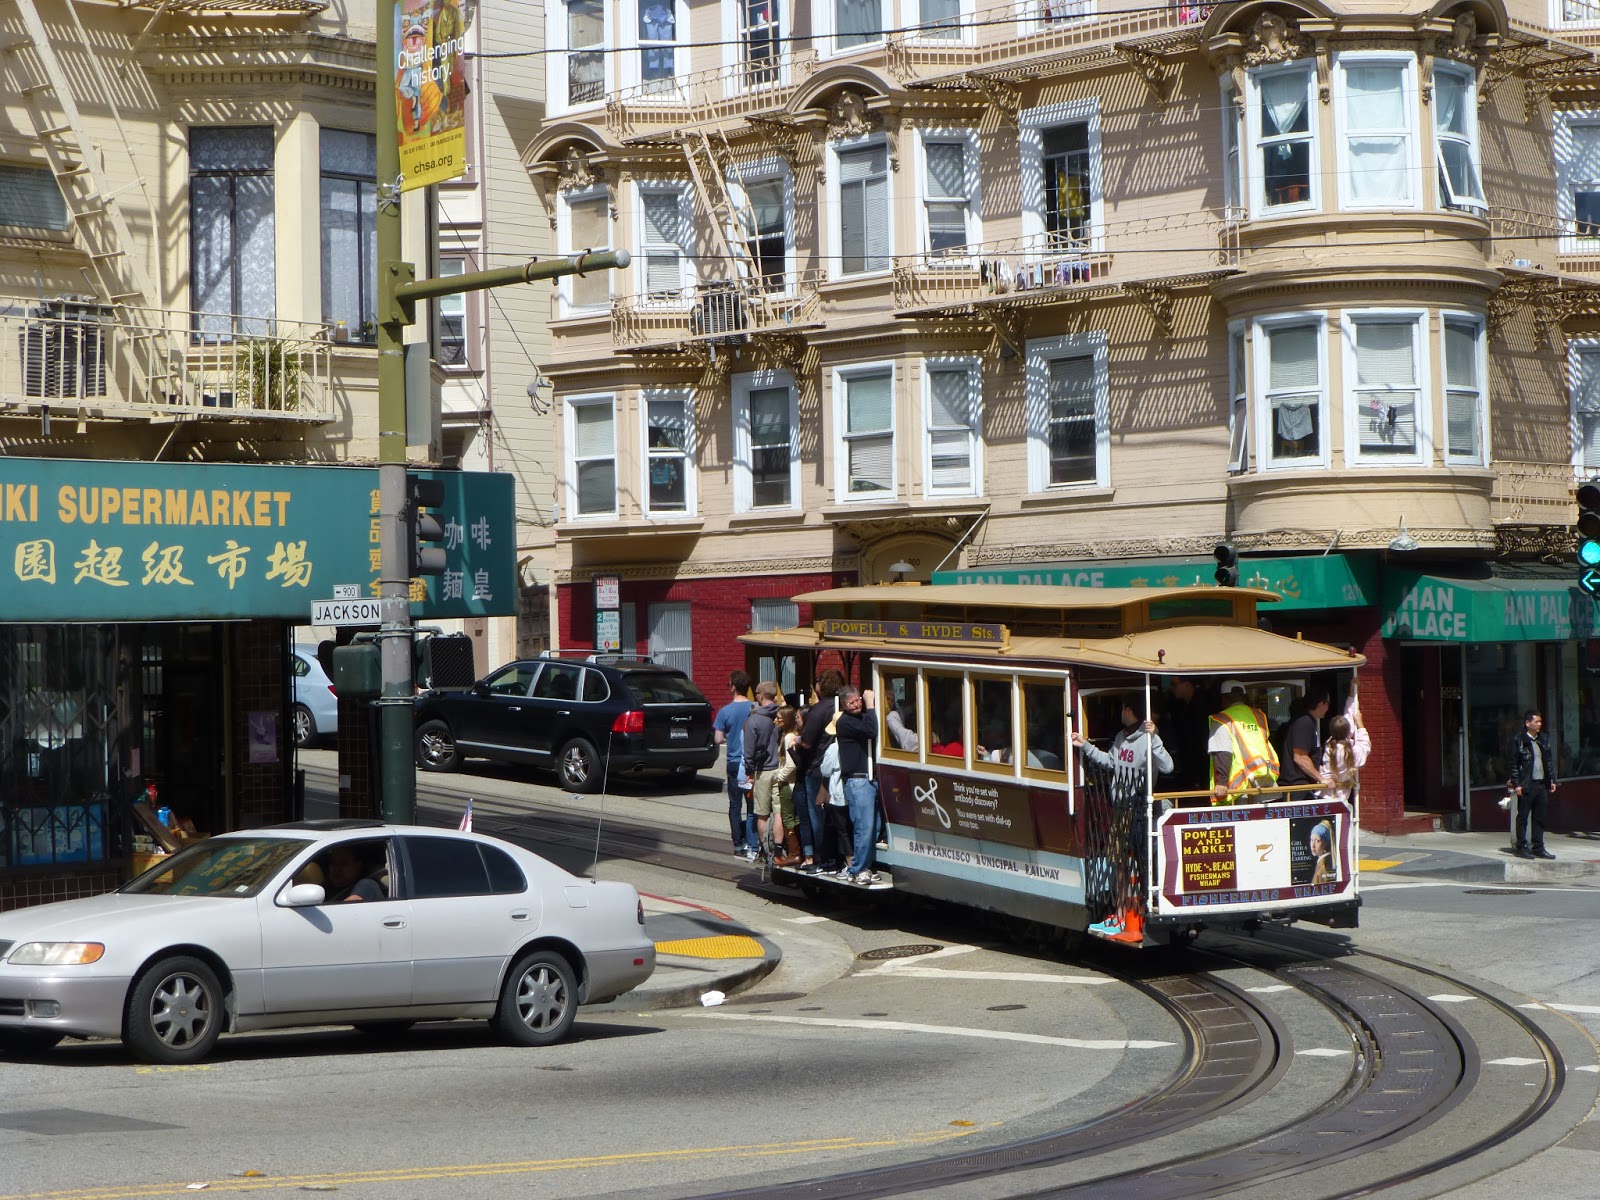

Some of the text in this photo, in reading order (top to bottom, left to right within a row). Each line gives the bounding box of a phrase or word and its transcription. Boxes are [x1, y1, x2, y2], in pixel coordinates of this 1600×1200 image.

[398, 36, 464, 69] Challenging
[412, 63, 451, 87] history.
[414, 154, 452, 174] chsa.org
[58, 485, 291, 527] SUPERMARKET
[444, 516, 492, 551] 咖啡
[15, 539, 313, 590] 園超級市場
[342, 586, 356, 596] 900
[1402, 586, 1454, 611] HAN
[315, 604, 380, 620] JACKSON
[1504, 595, 1594, 626] HAN PALACE
[831, 622, 995, 640] POWELL & HYDE Sts.
[1387, 612, 1466, 637] PALACE
[953, 782, 965, 792] Think
[966, 786, 979, 795] you're
[988, 788, 998, 798] with
[954, 794, 998, 810] antibody discovery?
[956, 808, 966, 818] You
[966, 812, 978, 820] were
[978, 812, 986, 820] set
[986, 813, 996, 823] with
[958, 820, 970, 828] once
[1188, 811, 1250, 824] MARKET
[1265, 806, 1320, 819] STREET
[1184, 830, 1232, 840] POWELL
[1197, 838, 1222, 846] AND
[1184, 844, 1234, 854] MARKET
[1256, 843, 1274, 862] 7
[909, 842, 1060, 880] SAN FRANCISCO MUNICIPAL RAILWAY
[1185, 862, 1202, 872] HYDE
[1212, 861, 1234, 872] BEACH
[1190, 872, 1230, 880] FISHERMANS
[1182, 884, 1336, 906] FISHERMANS WHARF
